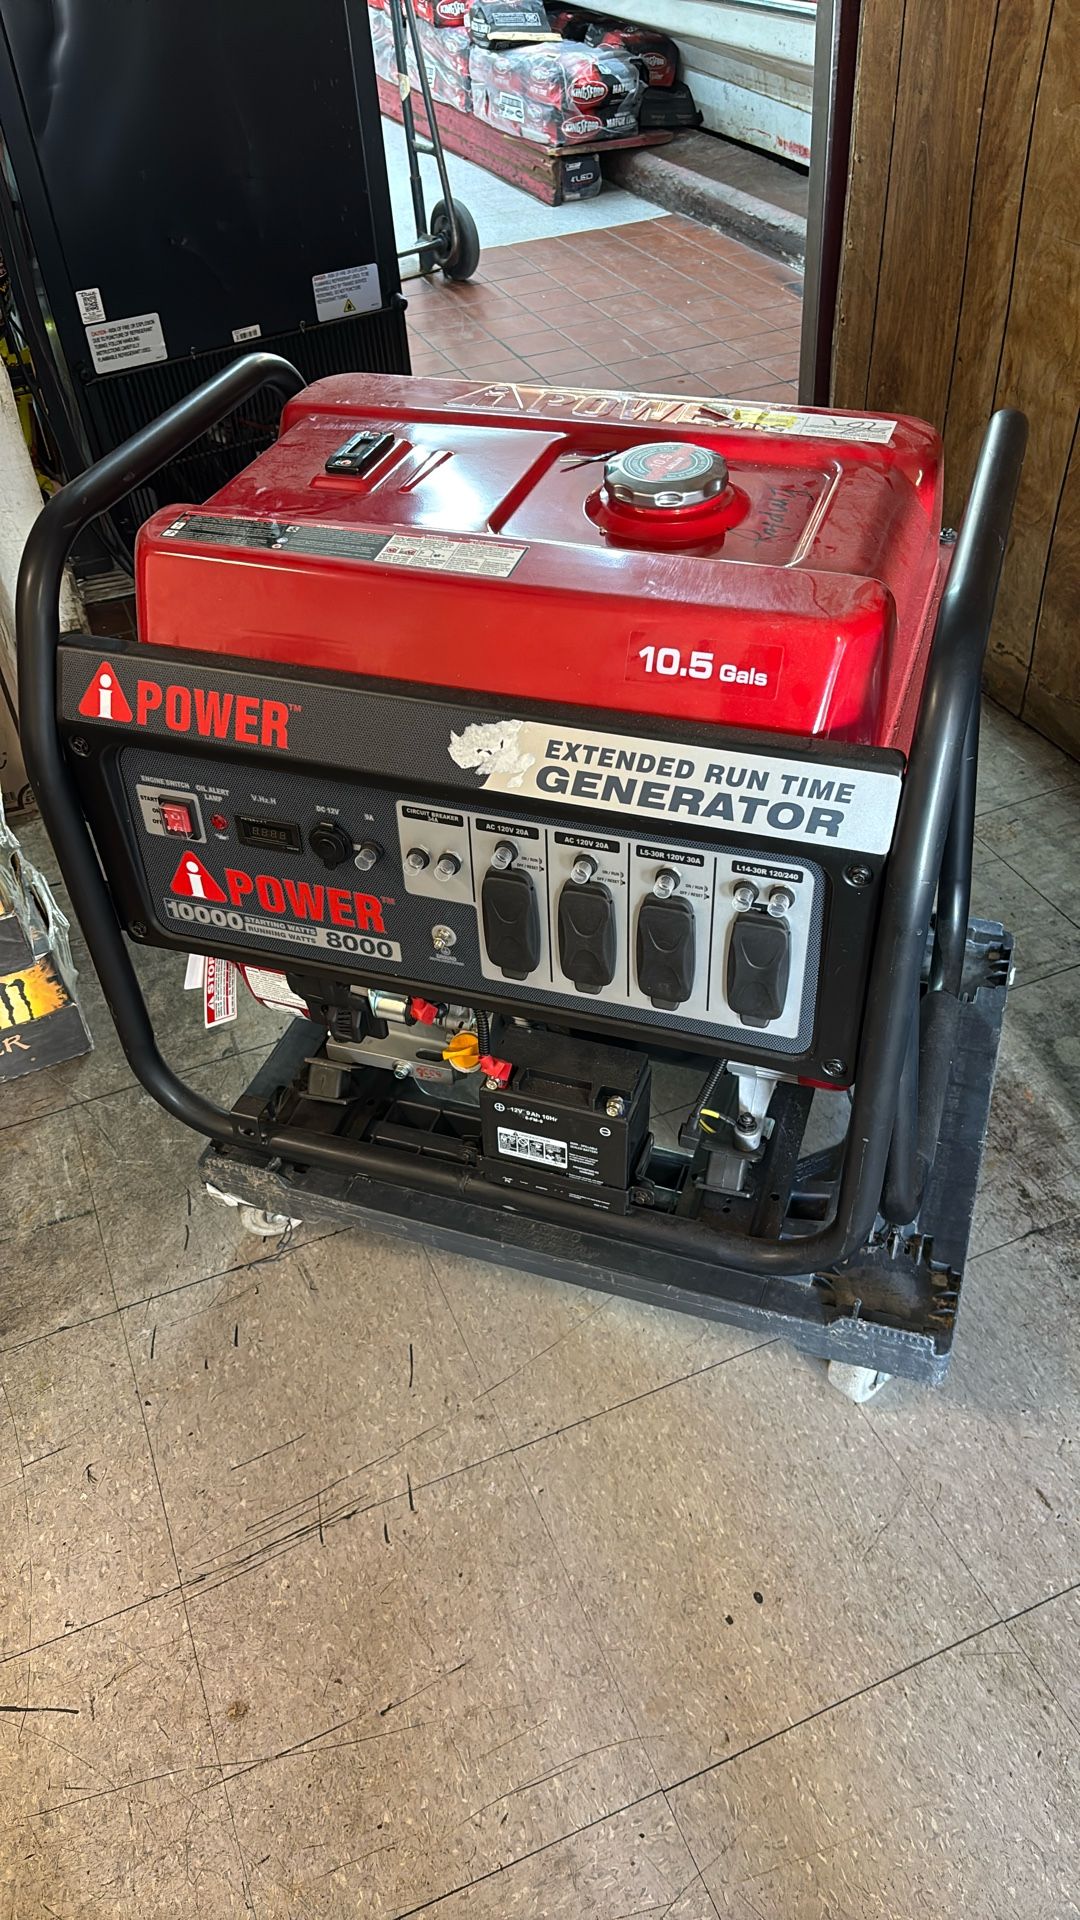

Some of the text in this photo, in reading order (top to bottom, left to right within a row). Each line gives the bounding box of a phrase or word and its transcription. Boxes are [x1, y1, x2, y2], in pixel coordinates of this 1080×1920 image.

[571, 84, 604, 100] KINGSFORD
[565, 119, 599, 135] KINGSFORD
[638, 646, 768, 687] 10.5 Gals
[545, 739, 856, 804] EXTENDED RUN TIME
[140, 775, 190, 789] ENGINE SWITCH
[195, 784, 230, 796] OIL ALERT
[140, 795, 158, 803] START
[204, 794, 223, 802] LAMP
[536, 765, 845, 838] GENERATOR
[406, 808, 459, 822] CIRCUIT BREAKER
[497, 825, 514, 834] 120V
[515, 828, 529, 836] 20A
[564, 836, 609, 850] AC 120V 20A
[639, 849, 701, 865] L5-30R 120V 30A
[736, 864, 799, 881] L14-30R 120/240
[167, 901, 317, 936] 10000 STARTING WATTS
[248, 926, 393, 958] RUNNING WATTS 8000
